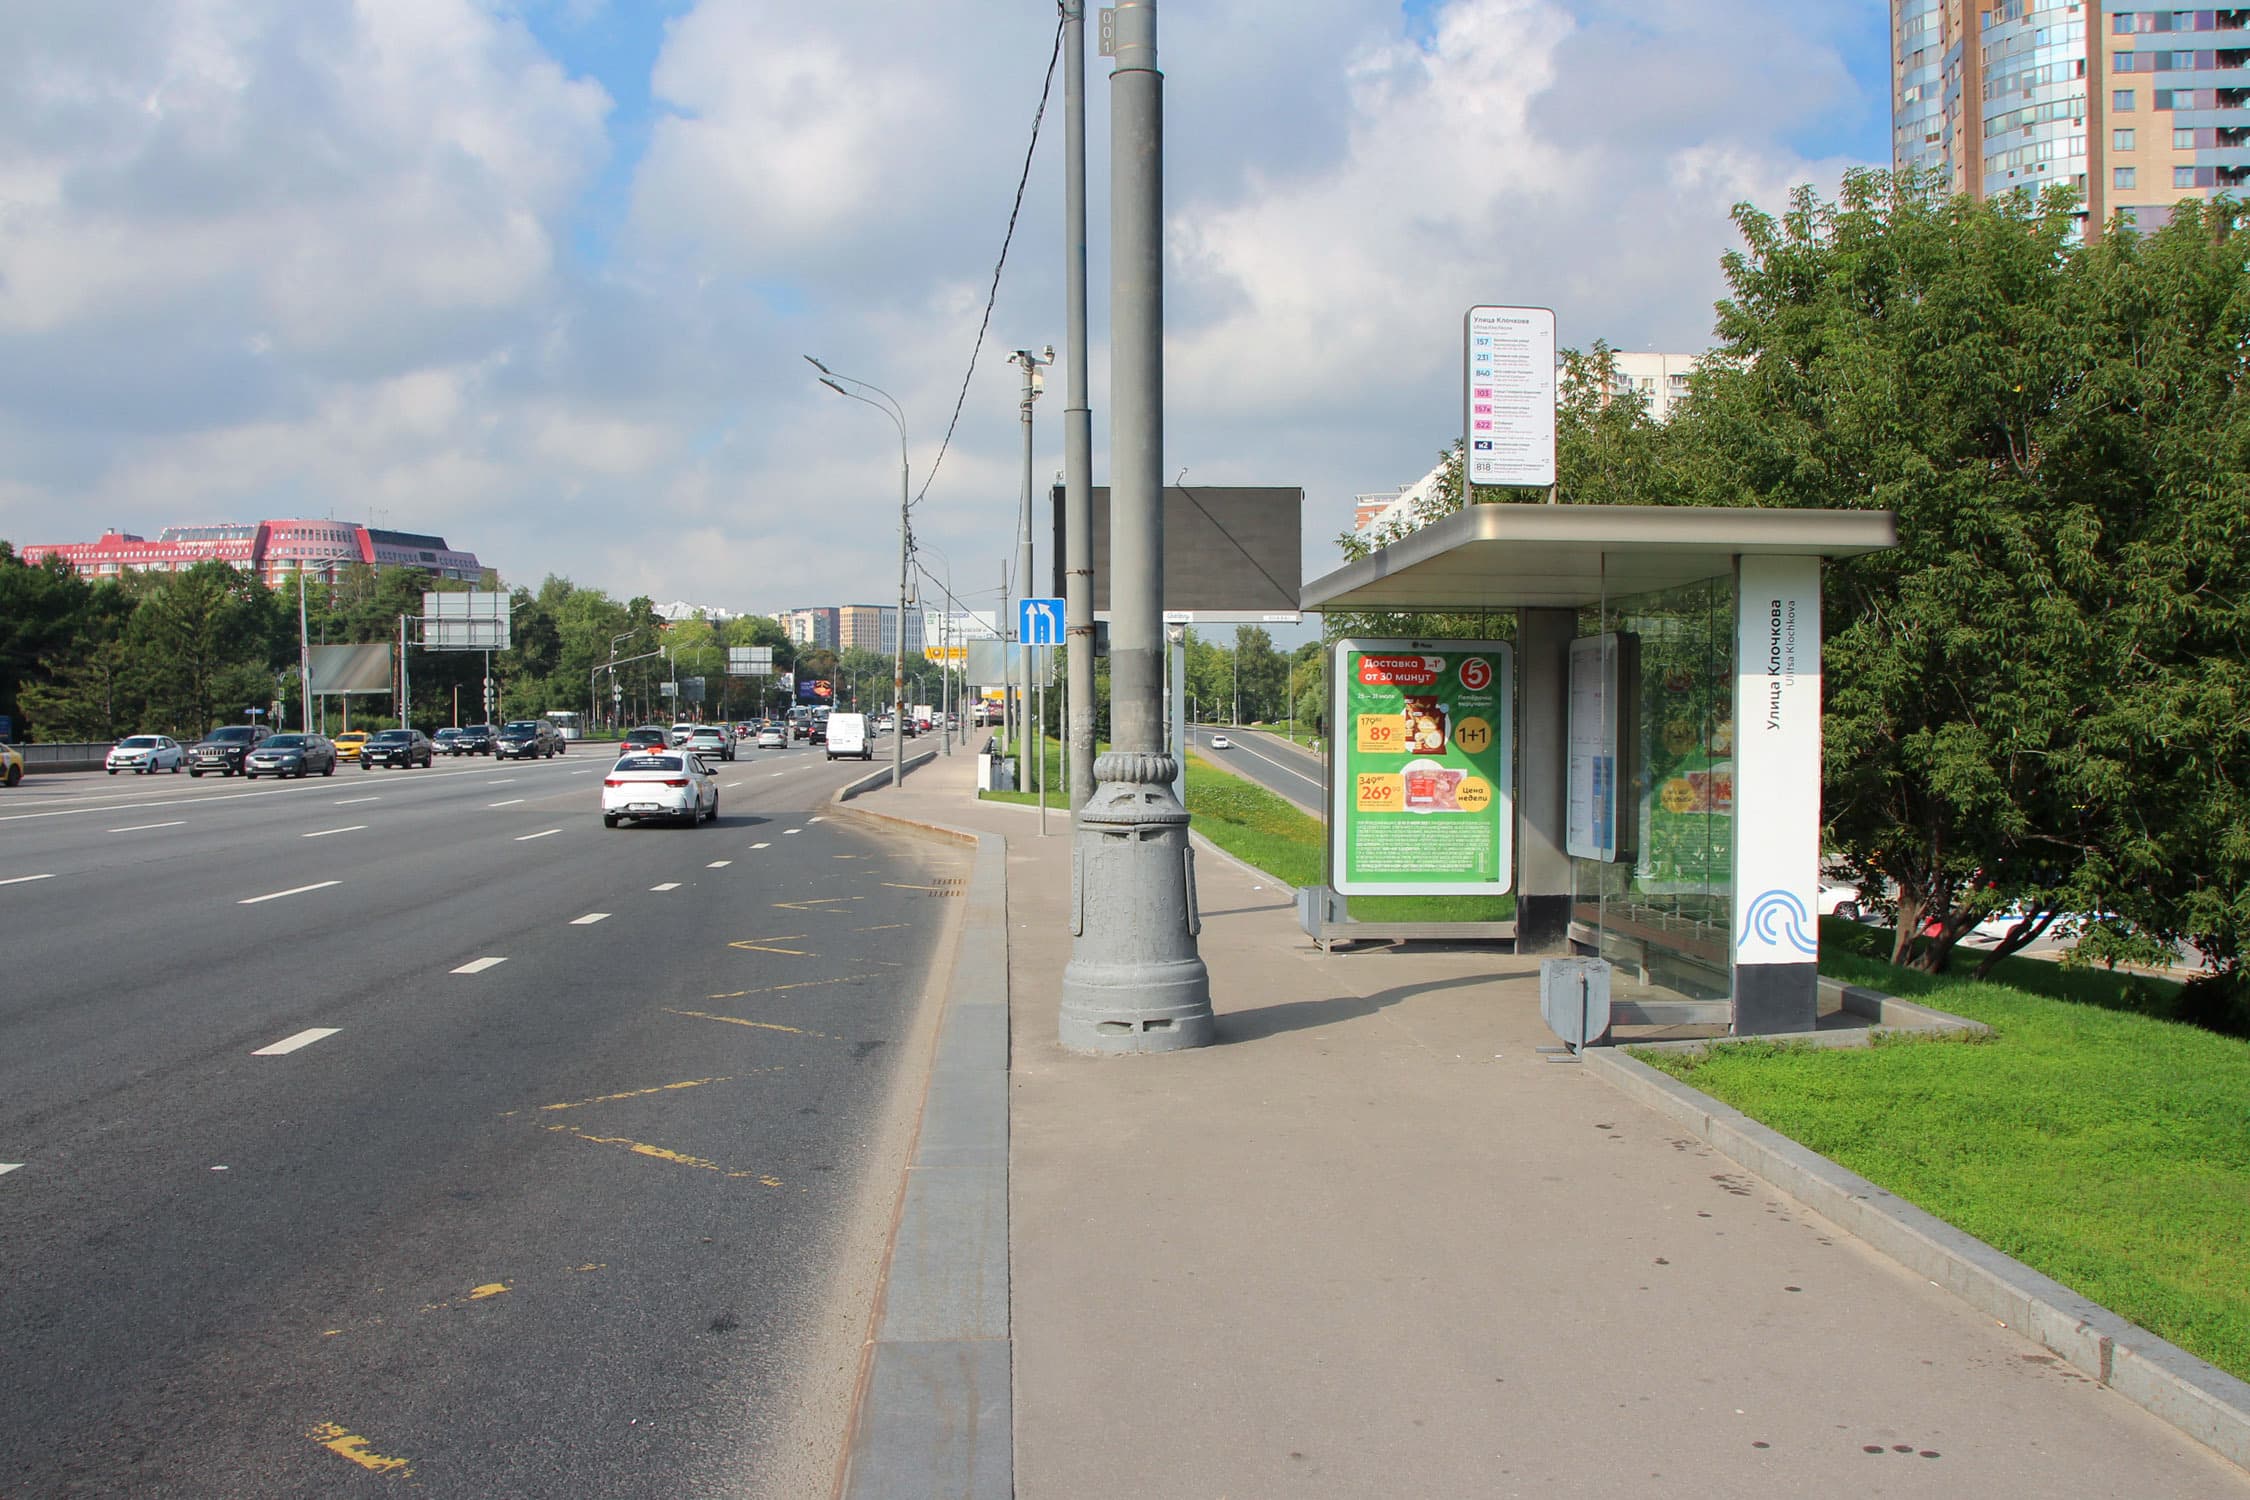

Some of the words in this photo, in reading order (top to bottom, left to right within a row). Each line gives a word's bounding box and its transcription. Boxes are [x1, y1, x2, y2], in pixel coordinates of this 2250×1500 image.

[1103, 11, 1112, 53] 001
[1473, 316, 1495, 325] Улица
[1496, 317, 1530, 325] Клочкова
[1476, 338, 1489, 346] 157
[1476, 390, 1490, 398] 103
[1475, 421, 1491, 429] 622
[1476, 463, 1492, 471] 818
[1785, 600, 1796, 654] Klochkova
[1767, 599, 1782, 676] Клочкова
[1364, 658, 1418, 669] Доставка
[1785, 656, 1795, 687] Ulitsa
[1365, 673, 1377, 681] от
[1380, 672, 1393, 681] 30
[1395, 673, 1431, 683] минут
[1767, 682, 1782, 730] Улица
[1370, 727, 1391, 741] 89
[1458, 727, 1487, 744] 1+1
[1462, 787, 1484, 795] Цена
[1458, 794, 1488, 802] недели
